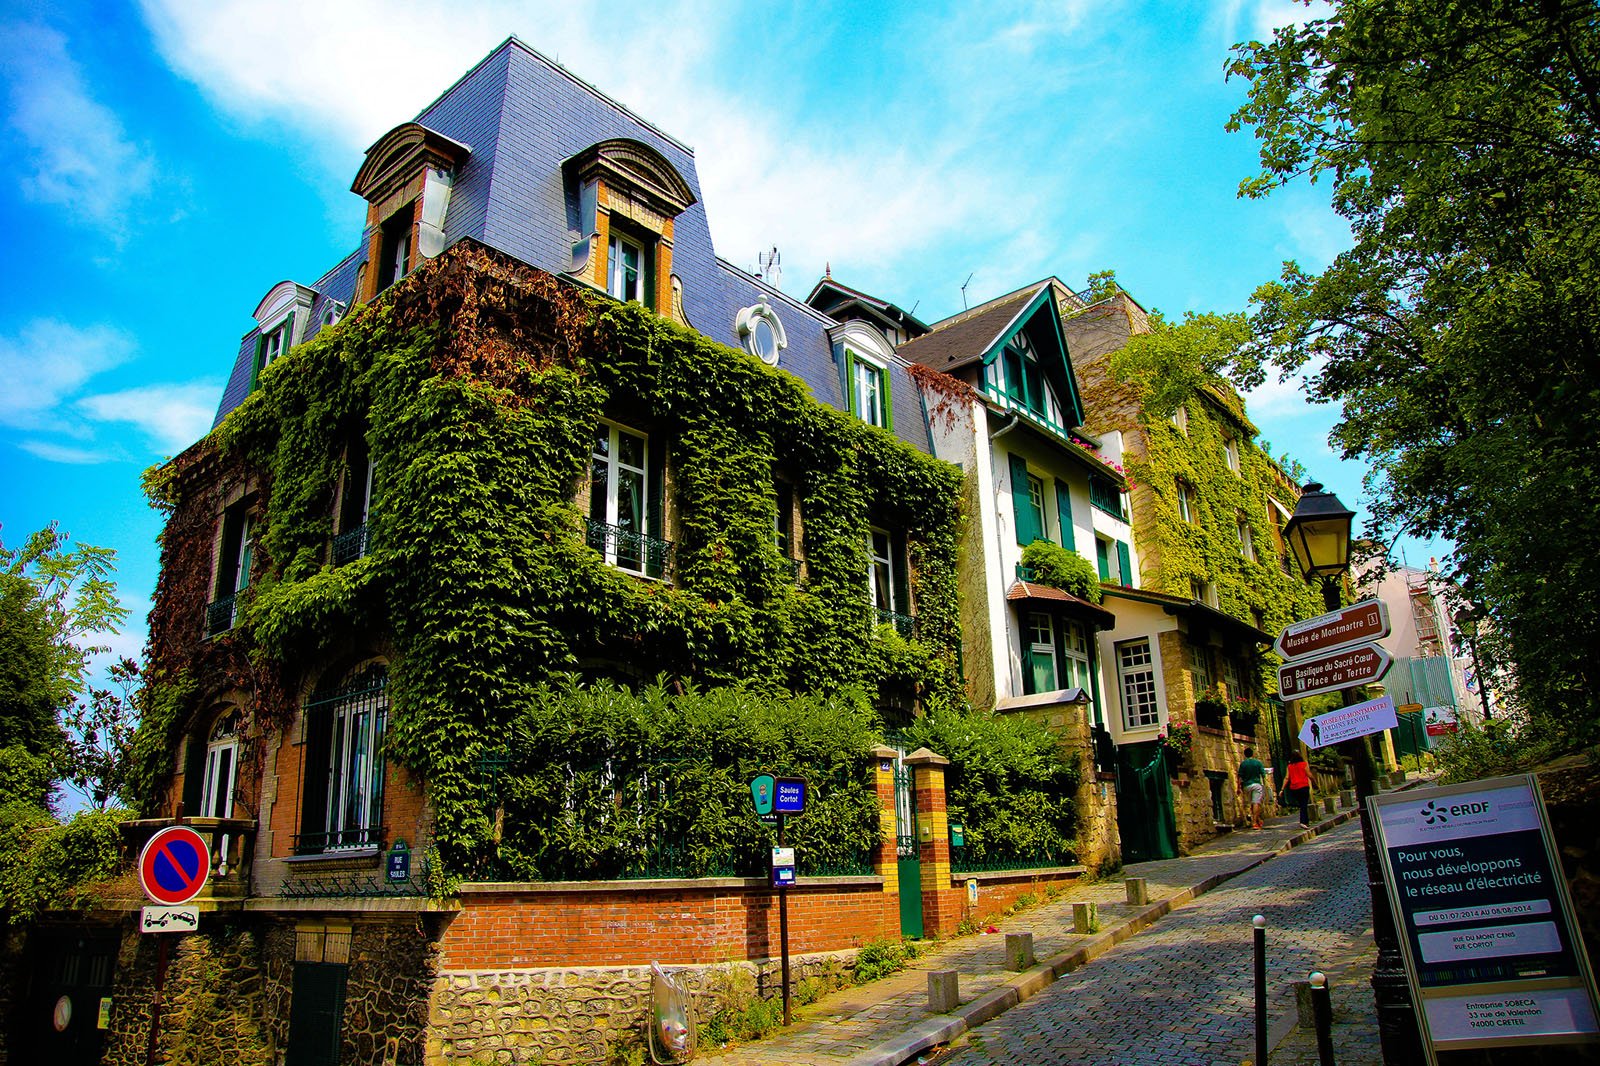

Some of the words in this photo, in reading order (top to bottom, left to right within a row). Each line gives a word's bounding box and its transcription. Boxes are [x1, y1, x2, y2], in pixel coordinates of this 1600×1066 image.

[1287, 635, 1309, 648] Musée
[1311, 632, 1319, 641] de
[1321, 620, 1364, 638] Montmartre
[1295, 665, 1323, 679] Basilique
[1324, 662, 1333, 672] du
[1334, 655, 1353, 669] Sacré
[1354, 653, 1374, 664] Cœur
[1307, 676, 1329, 688] Place
[1333, 672, 1342, 681] du
[1346, 666, 1371, 678] Tertre
[1347, 702, 1388, 719] MONTMARTRE
[780, 786, 799, 794] Saules
[780, 795, 798, 803] Cortot
[1398, 851, 1428, 864] Pour
[1429, 847, 1464, 860] vous,
[1402, 867, 1434, 880] nous
[1436, 857, 1522, 876] développons
[1406, 886, 1418, 898] le
[1420, 881, 1462, 895] réseau
[1466, 871, 1542, 891] d'électricité
[1466, 1002, 1503, 1010] Entreprise
[1506, 1008, 1542, 1016] Valenton
[1470, 1020, 1495, 1028] 94000
